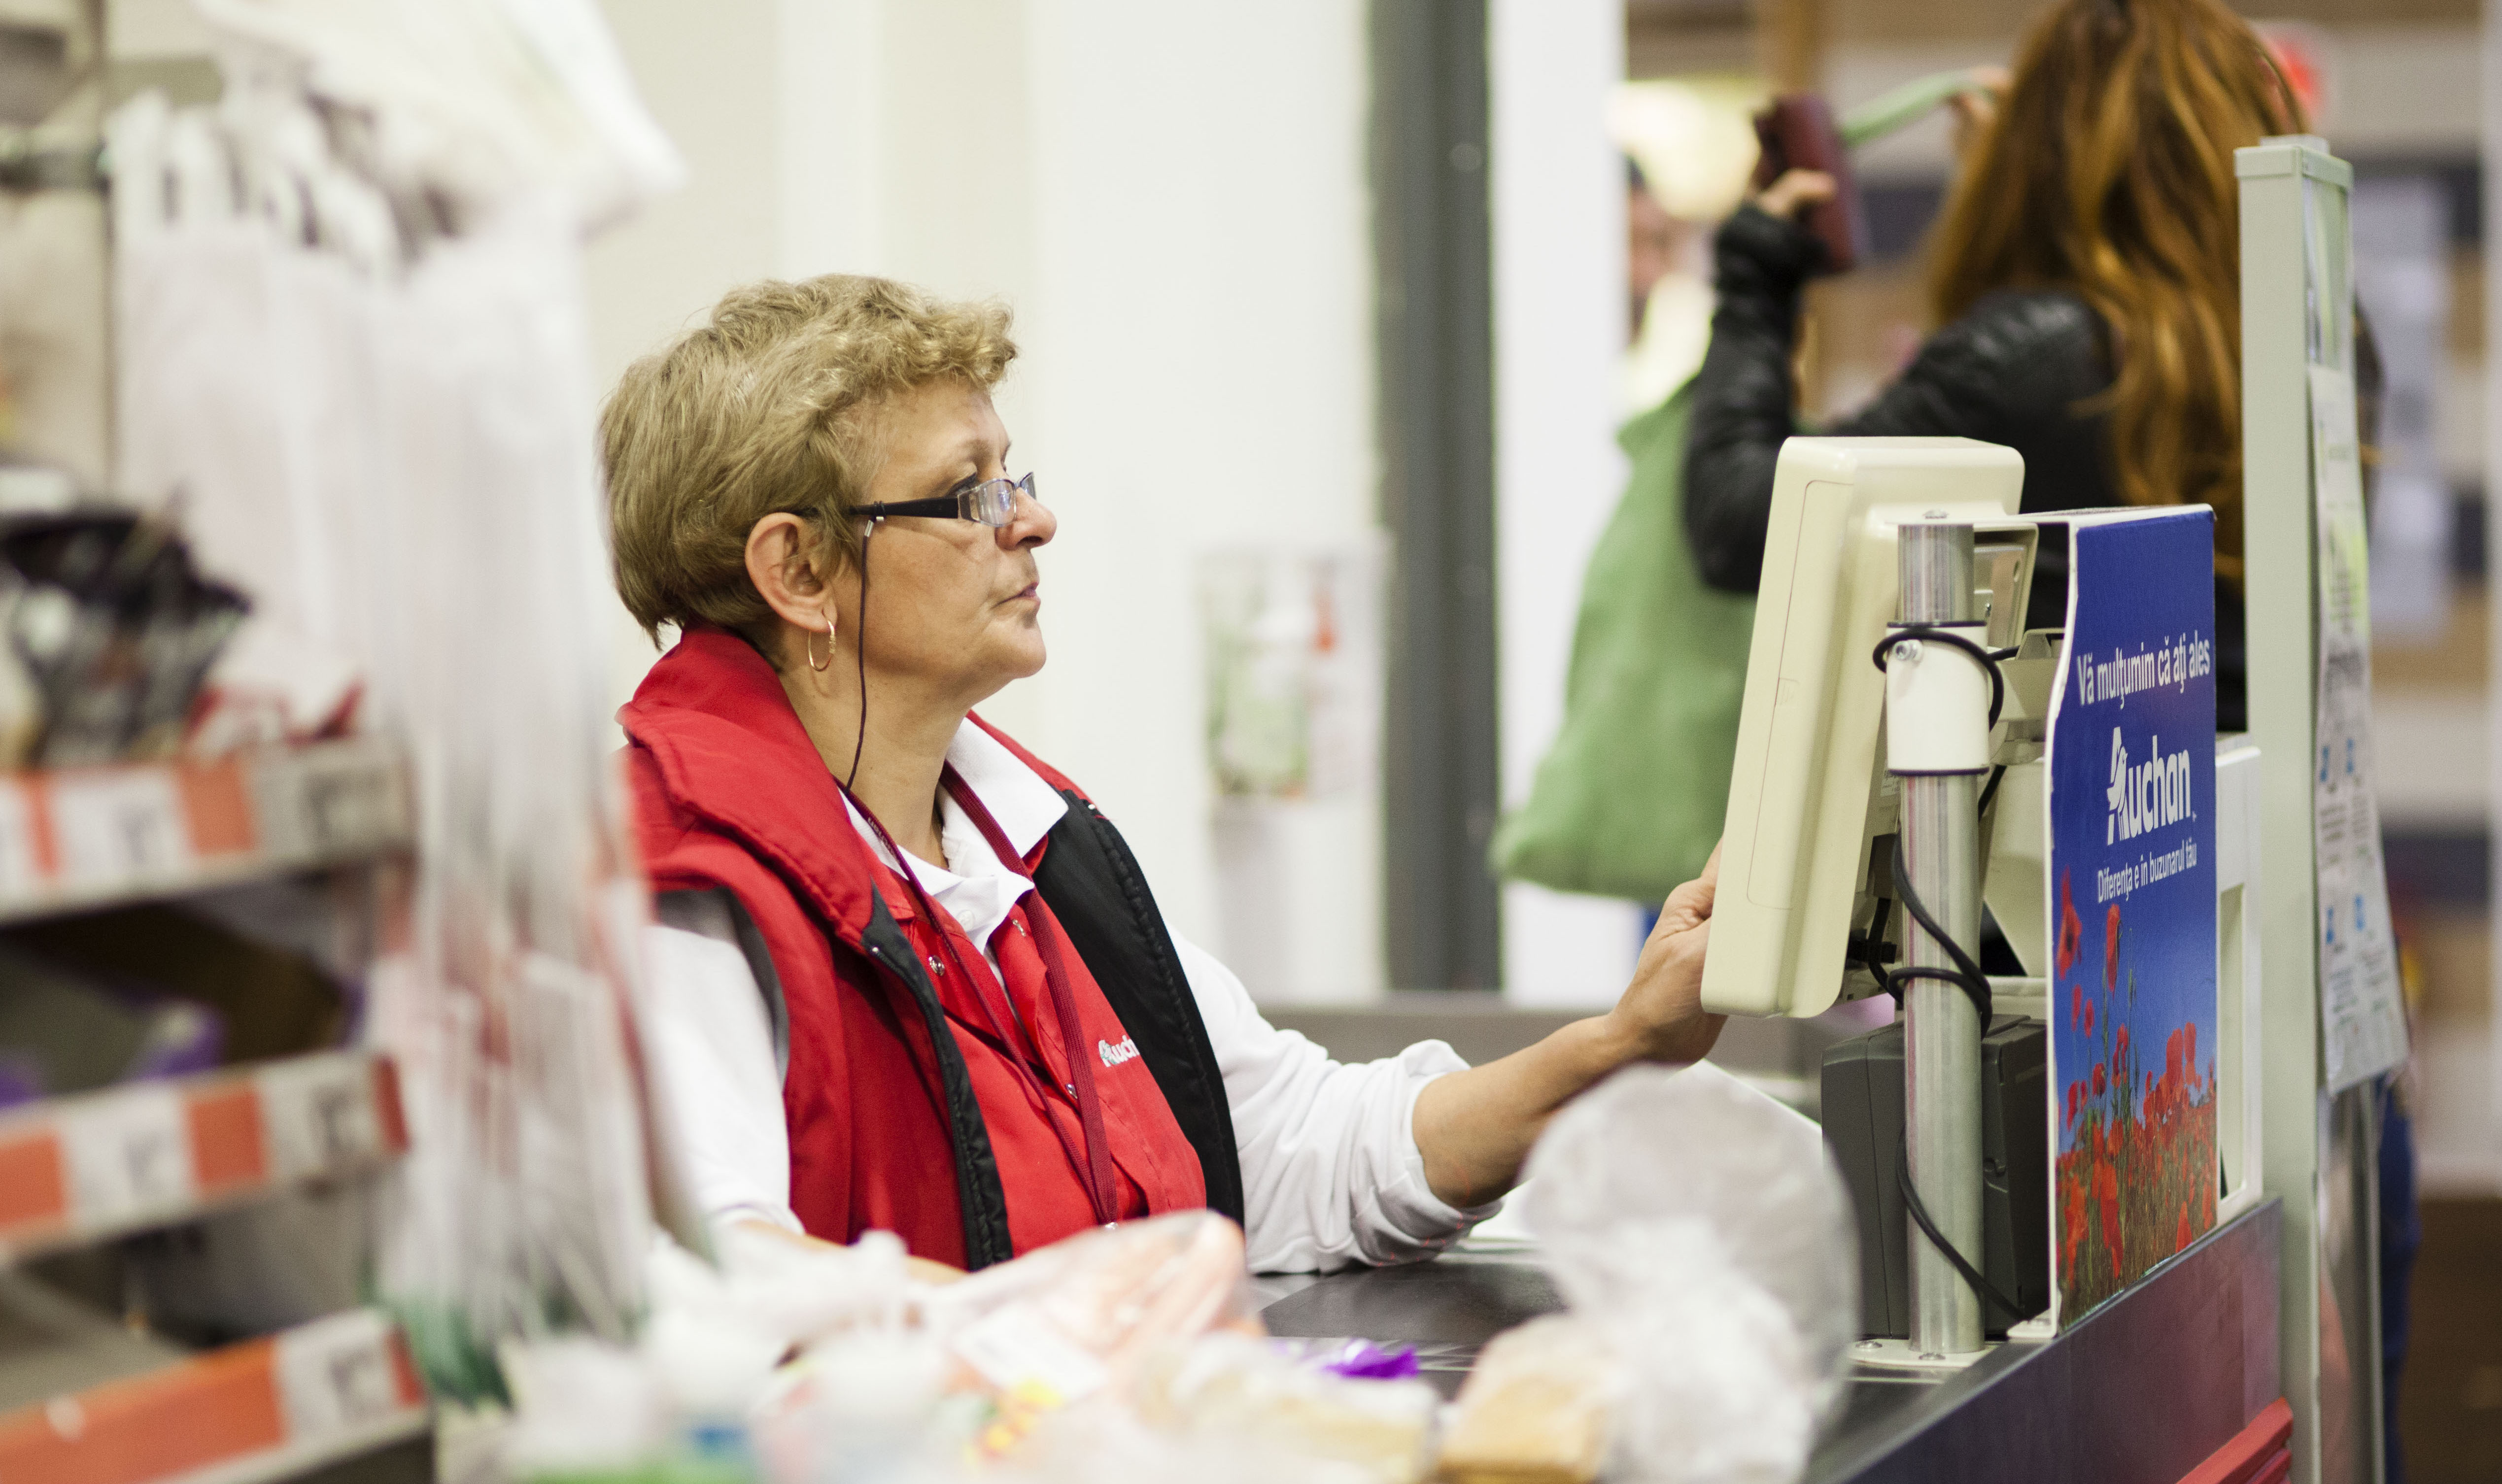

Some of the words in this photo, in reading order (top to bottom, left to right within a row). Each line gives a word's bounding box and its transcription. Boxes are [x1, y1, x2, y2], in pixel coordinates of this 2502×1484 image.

[2076, 652, 2094, 706] Vă
[2158, 635, 2171, 686] că
[2189, 630, 2210, 679] ales
[2107, 726, 2191, 846] Auchan
[2134, 864, 2139, 889] e
[2140, 854, 2148, 887] în
[2150, 839, 2185, 883] buzunarul
[1098, 1034, 1140, 1068] Auch
